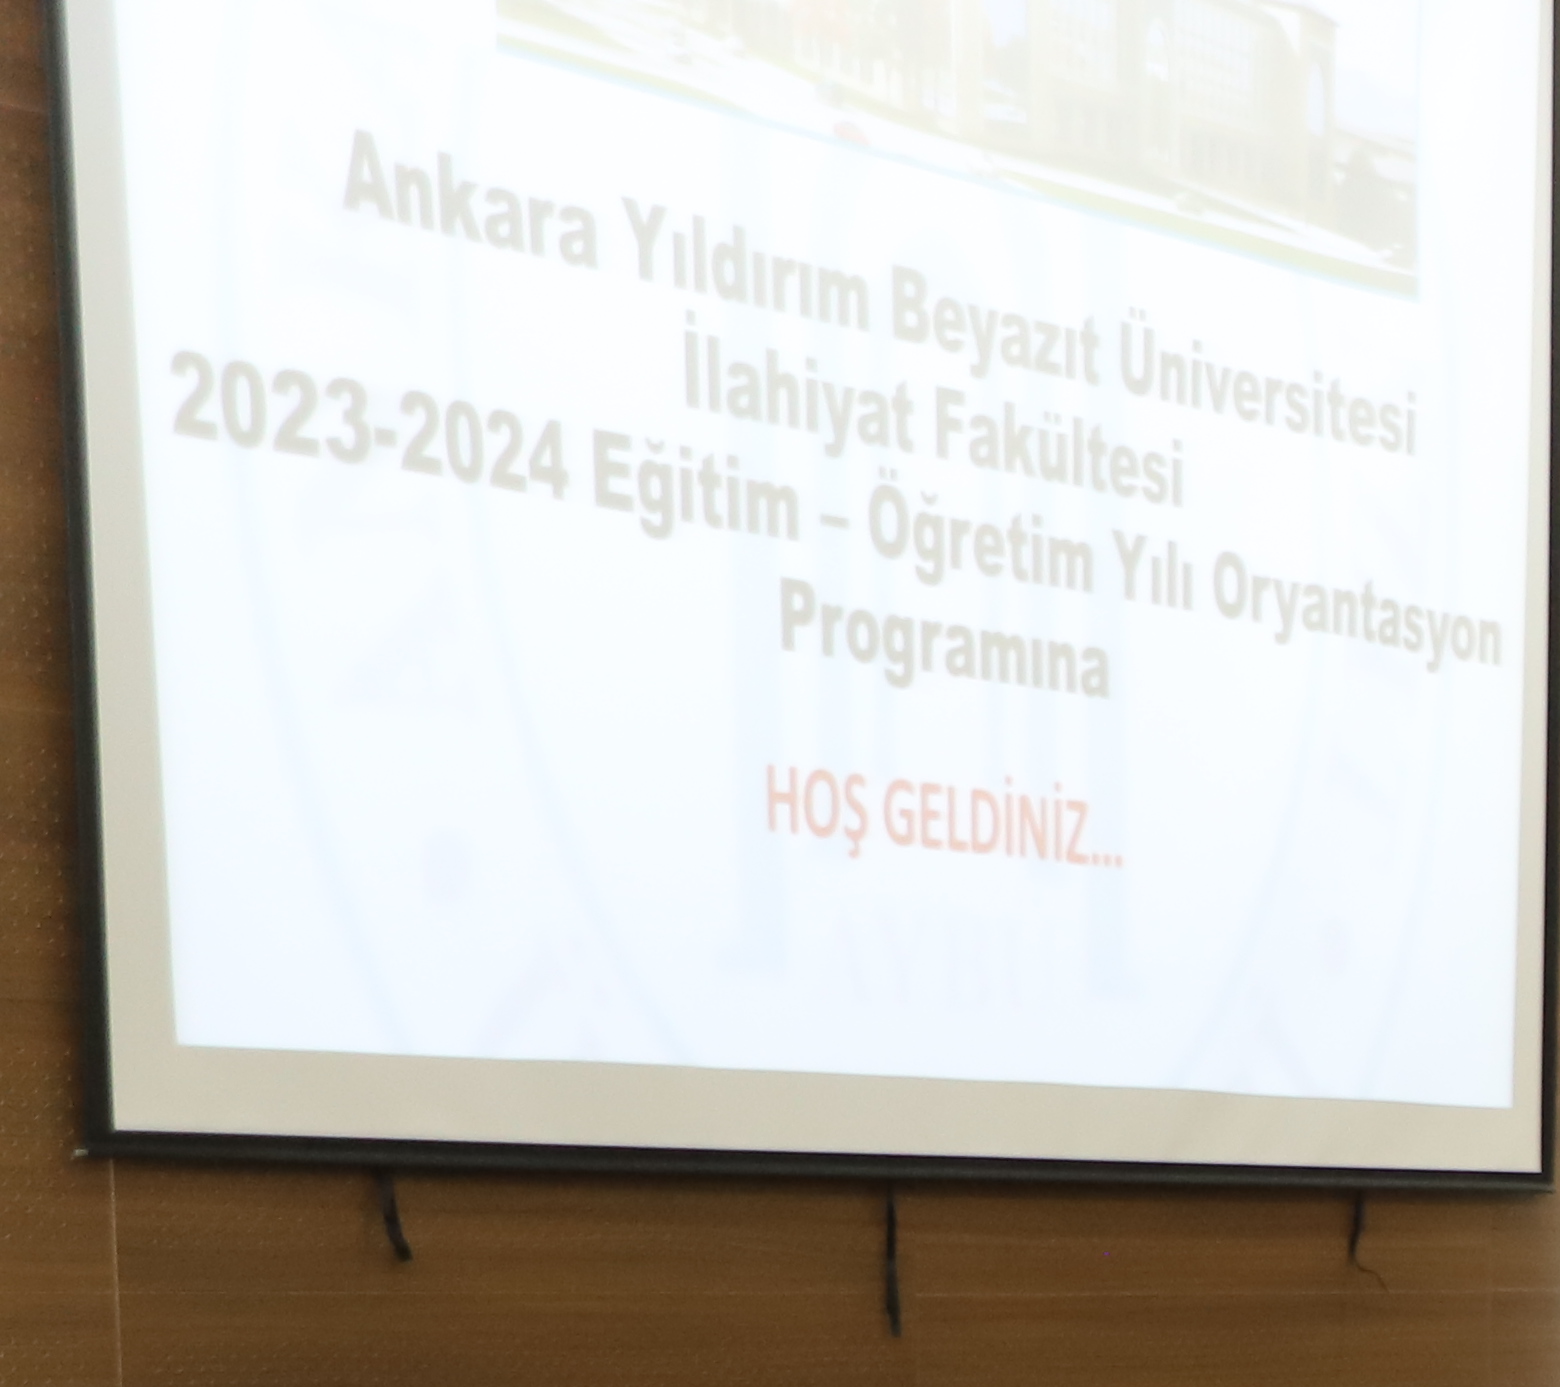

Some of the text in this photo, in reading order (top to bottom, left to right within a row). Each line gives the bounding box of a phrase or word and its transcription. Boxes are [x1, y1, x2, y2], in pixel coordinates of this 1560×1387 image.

[343, 129, 1417, 456] Ankara Yıldırım Beyazıt Üniversitesi
[683, 309, 1184, 508] İlahiyat Fakültesi
[171, 351, 569, 499] 2023-2024
[593, 430, 799, 542] Eğitim
[867, 468, 1094, 593] Öğretim
[1112, 528, 1193, 613] Yılı
[1213, 553, 1502, 671] Oryantasyon
[780, 577, 1111, 702] Programına
[765, 764, 868, 858] HOŞ
